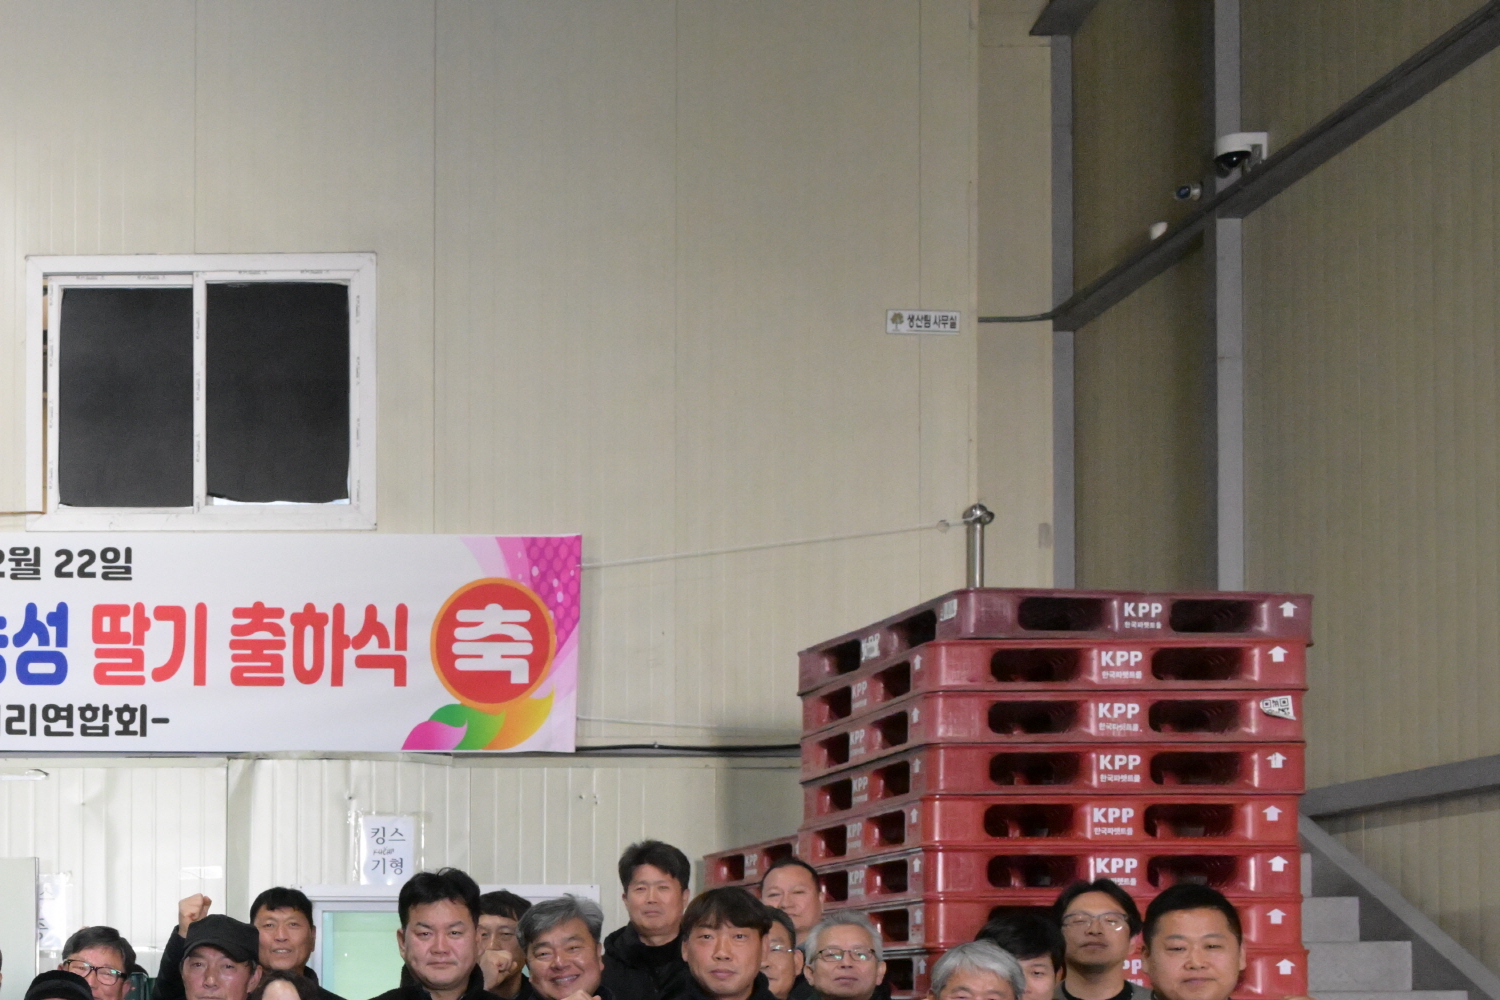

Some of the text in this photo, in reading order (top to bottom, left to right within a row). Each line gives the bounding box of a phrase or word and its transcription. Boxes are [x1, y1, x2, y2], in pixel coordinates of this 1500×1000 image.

[907, 314, 957, 329] 생산팀 사무실
[54, 547, 133, 581] 22일
[1124, 602, 1162, 617] KPP
[91, 602, 208, 687] 딸기
[229, 602, 409, 687] 출하식
[451, 606, 529, 687] 축
[1101, 651, 1142, 666] KPP
[1098, 703, 1139, 718] KPP
[1100, 755, 1140, 770] KPP
[1093, 808, 1134, 823] KPP
[370, 826, 406, 845] 킹스
[371, 857, 404, 875] 기형
[1096, 858, 1137, 873] KPP
